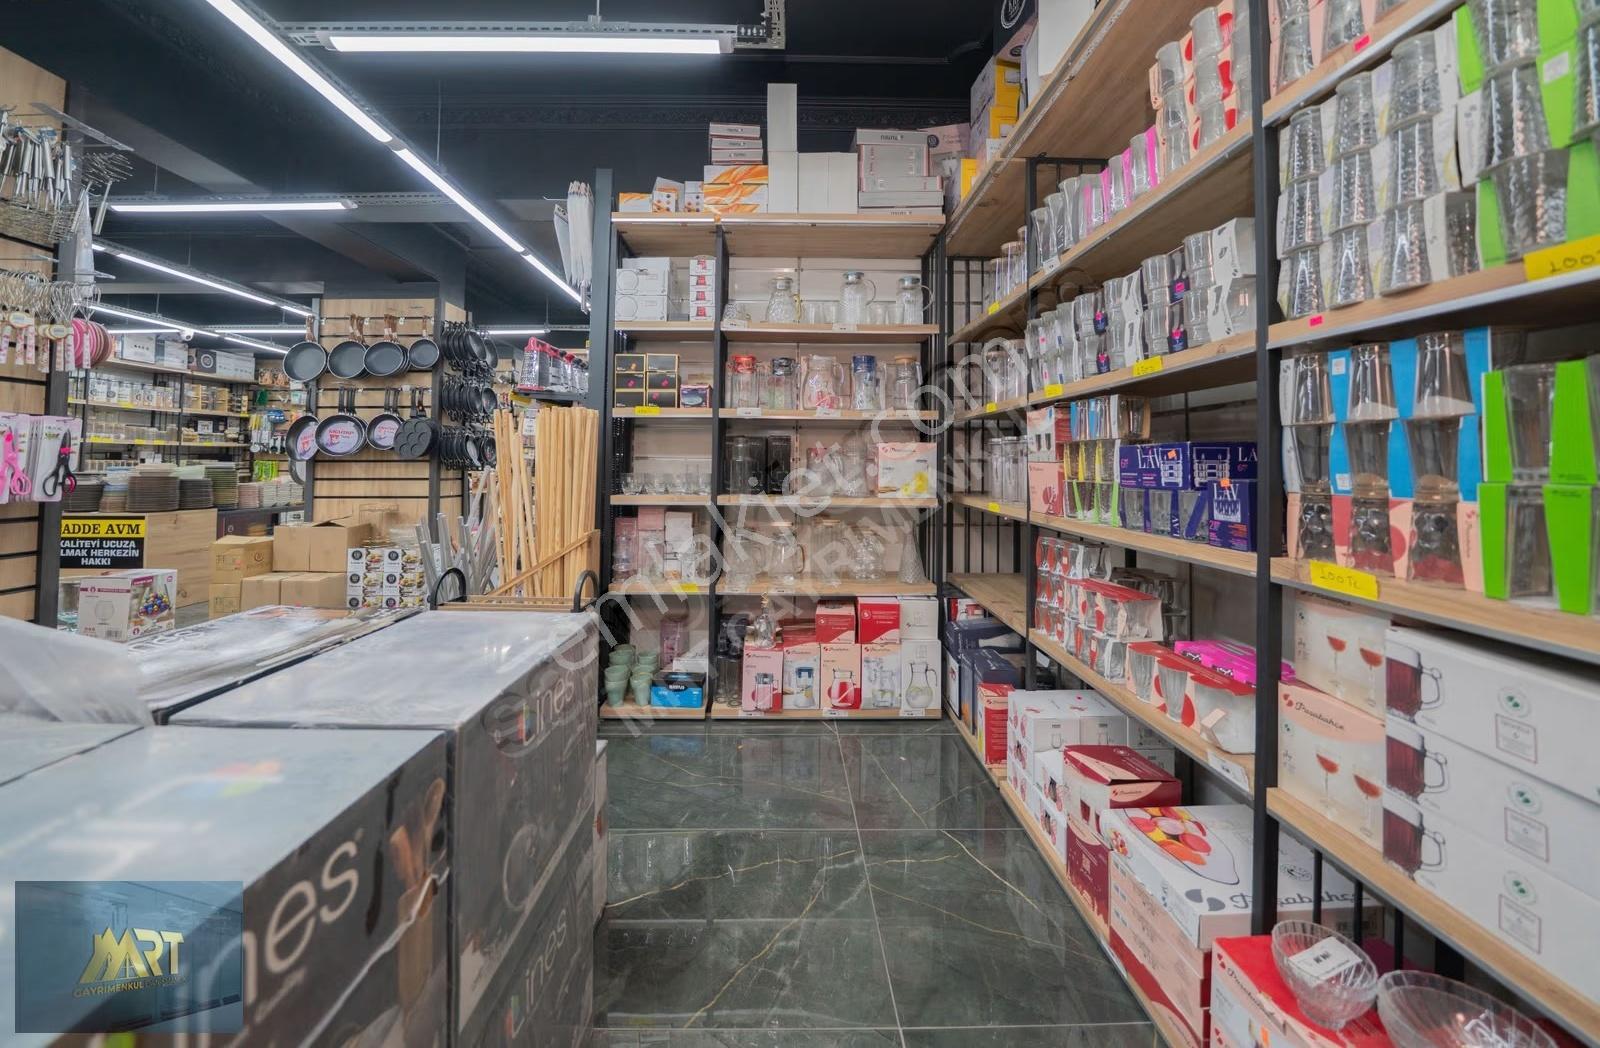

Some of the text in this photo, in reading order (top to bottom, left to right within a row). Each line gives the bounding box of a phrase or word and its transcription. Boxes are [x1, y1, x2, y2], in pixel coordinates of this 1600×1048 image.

[1238, 447, 1258, 461] LA
[61, 523, 141, 535] ADDE AVM
[102, 540, 136, 548] UCUZA
[60, 548, 139, 557] LMAK HERKEZİN
[81, 557, 111, 566] HAKKI
